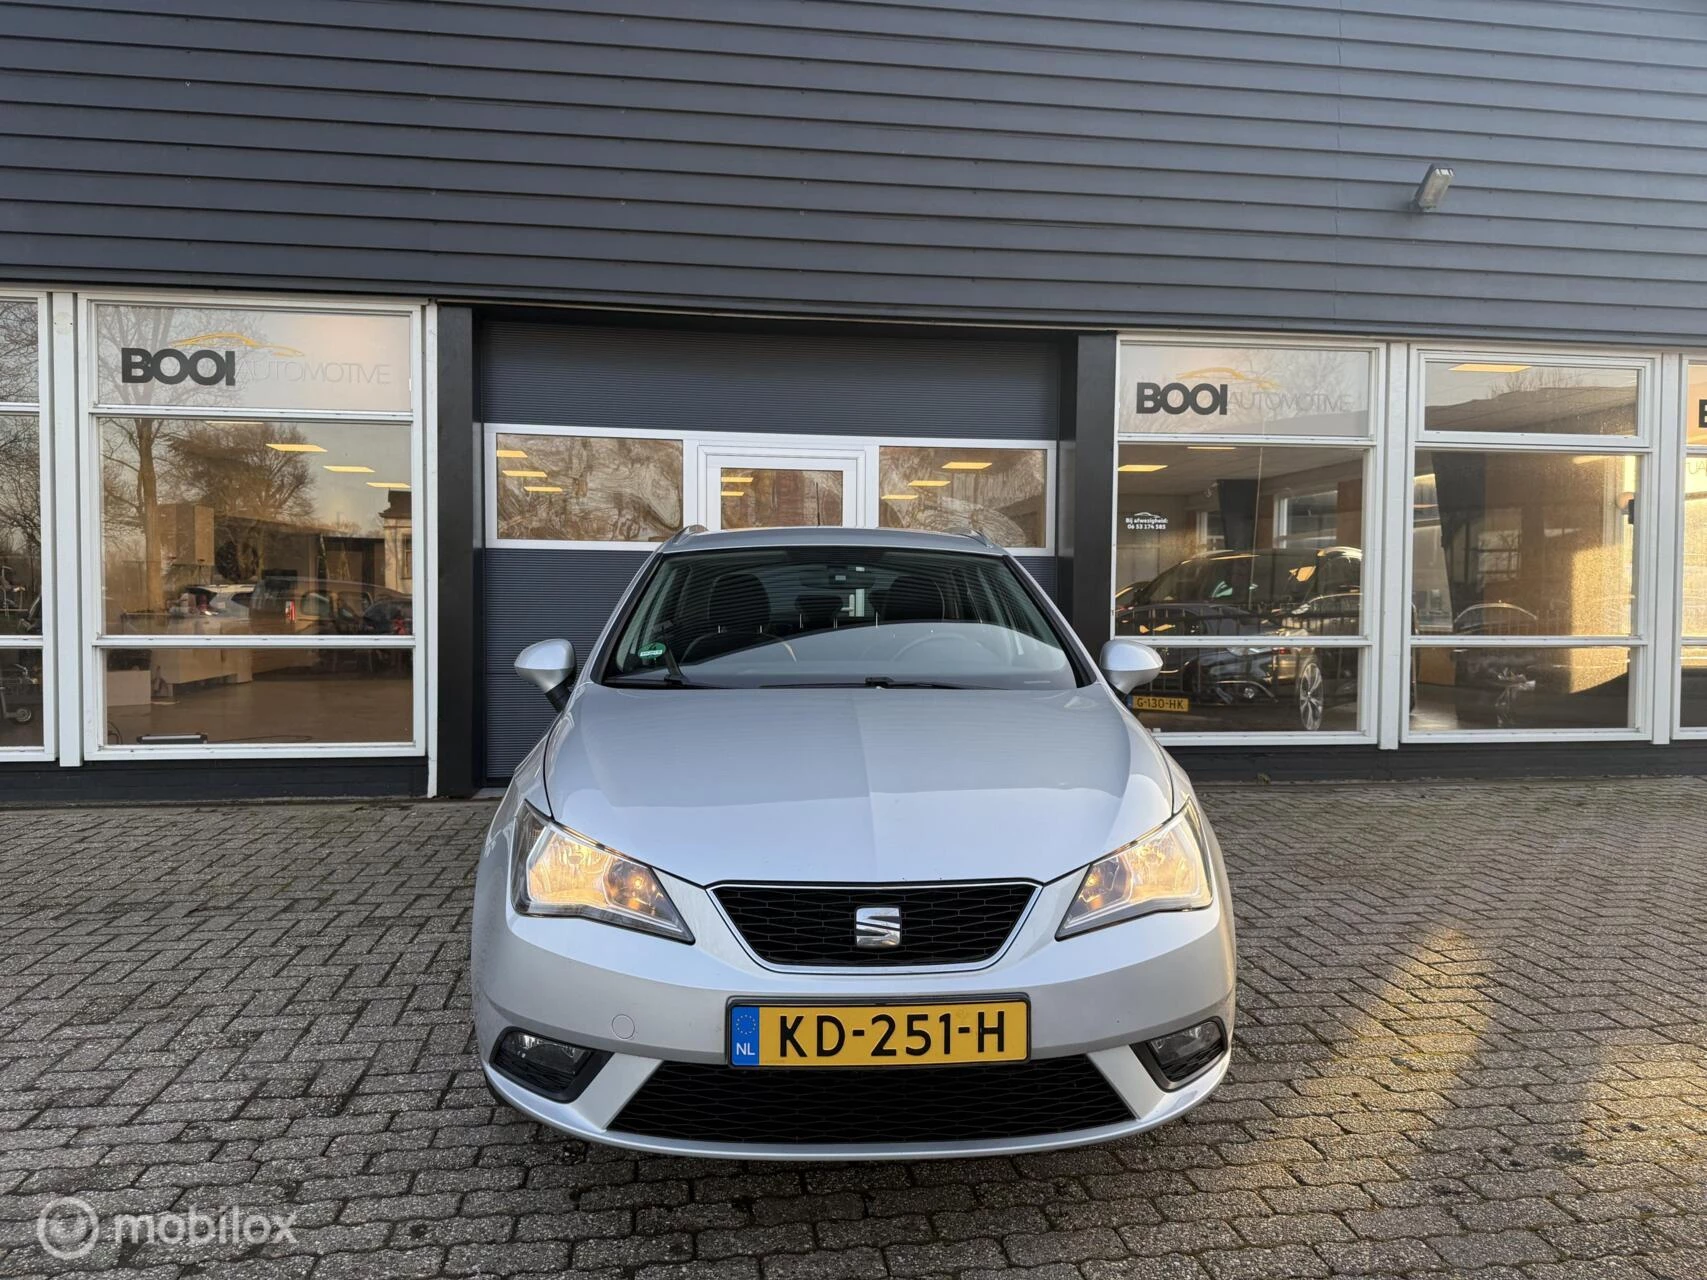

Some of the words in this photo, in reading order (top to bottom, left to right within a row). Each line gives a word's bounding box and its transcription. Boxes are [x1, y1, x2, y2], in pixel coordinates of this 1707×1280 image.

[121, 347, 236, 387] BOOI
[234, 359, 392, 385] AUTOMOTIVE
[1136, 381, 1228, 416] BOOI
[1228, 391, 1352, 412] AUTOMOTIVE
[1136, 697, 1185, 709] G-130-HK
[735, 1042, 756, 1056] NL
[779, 1010, 1005, 1058] KD-251-H
